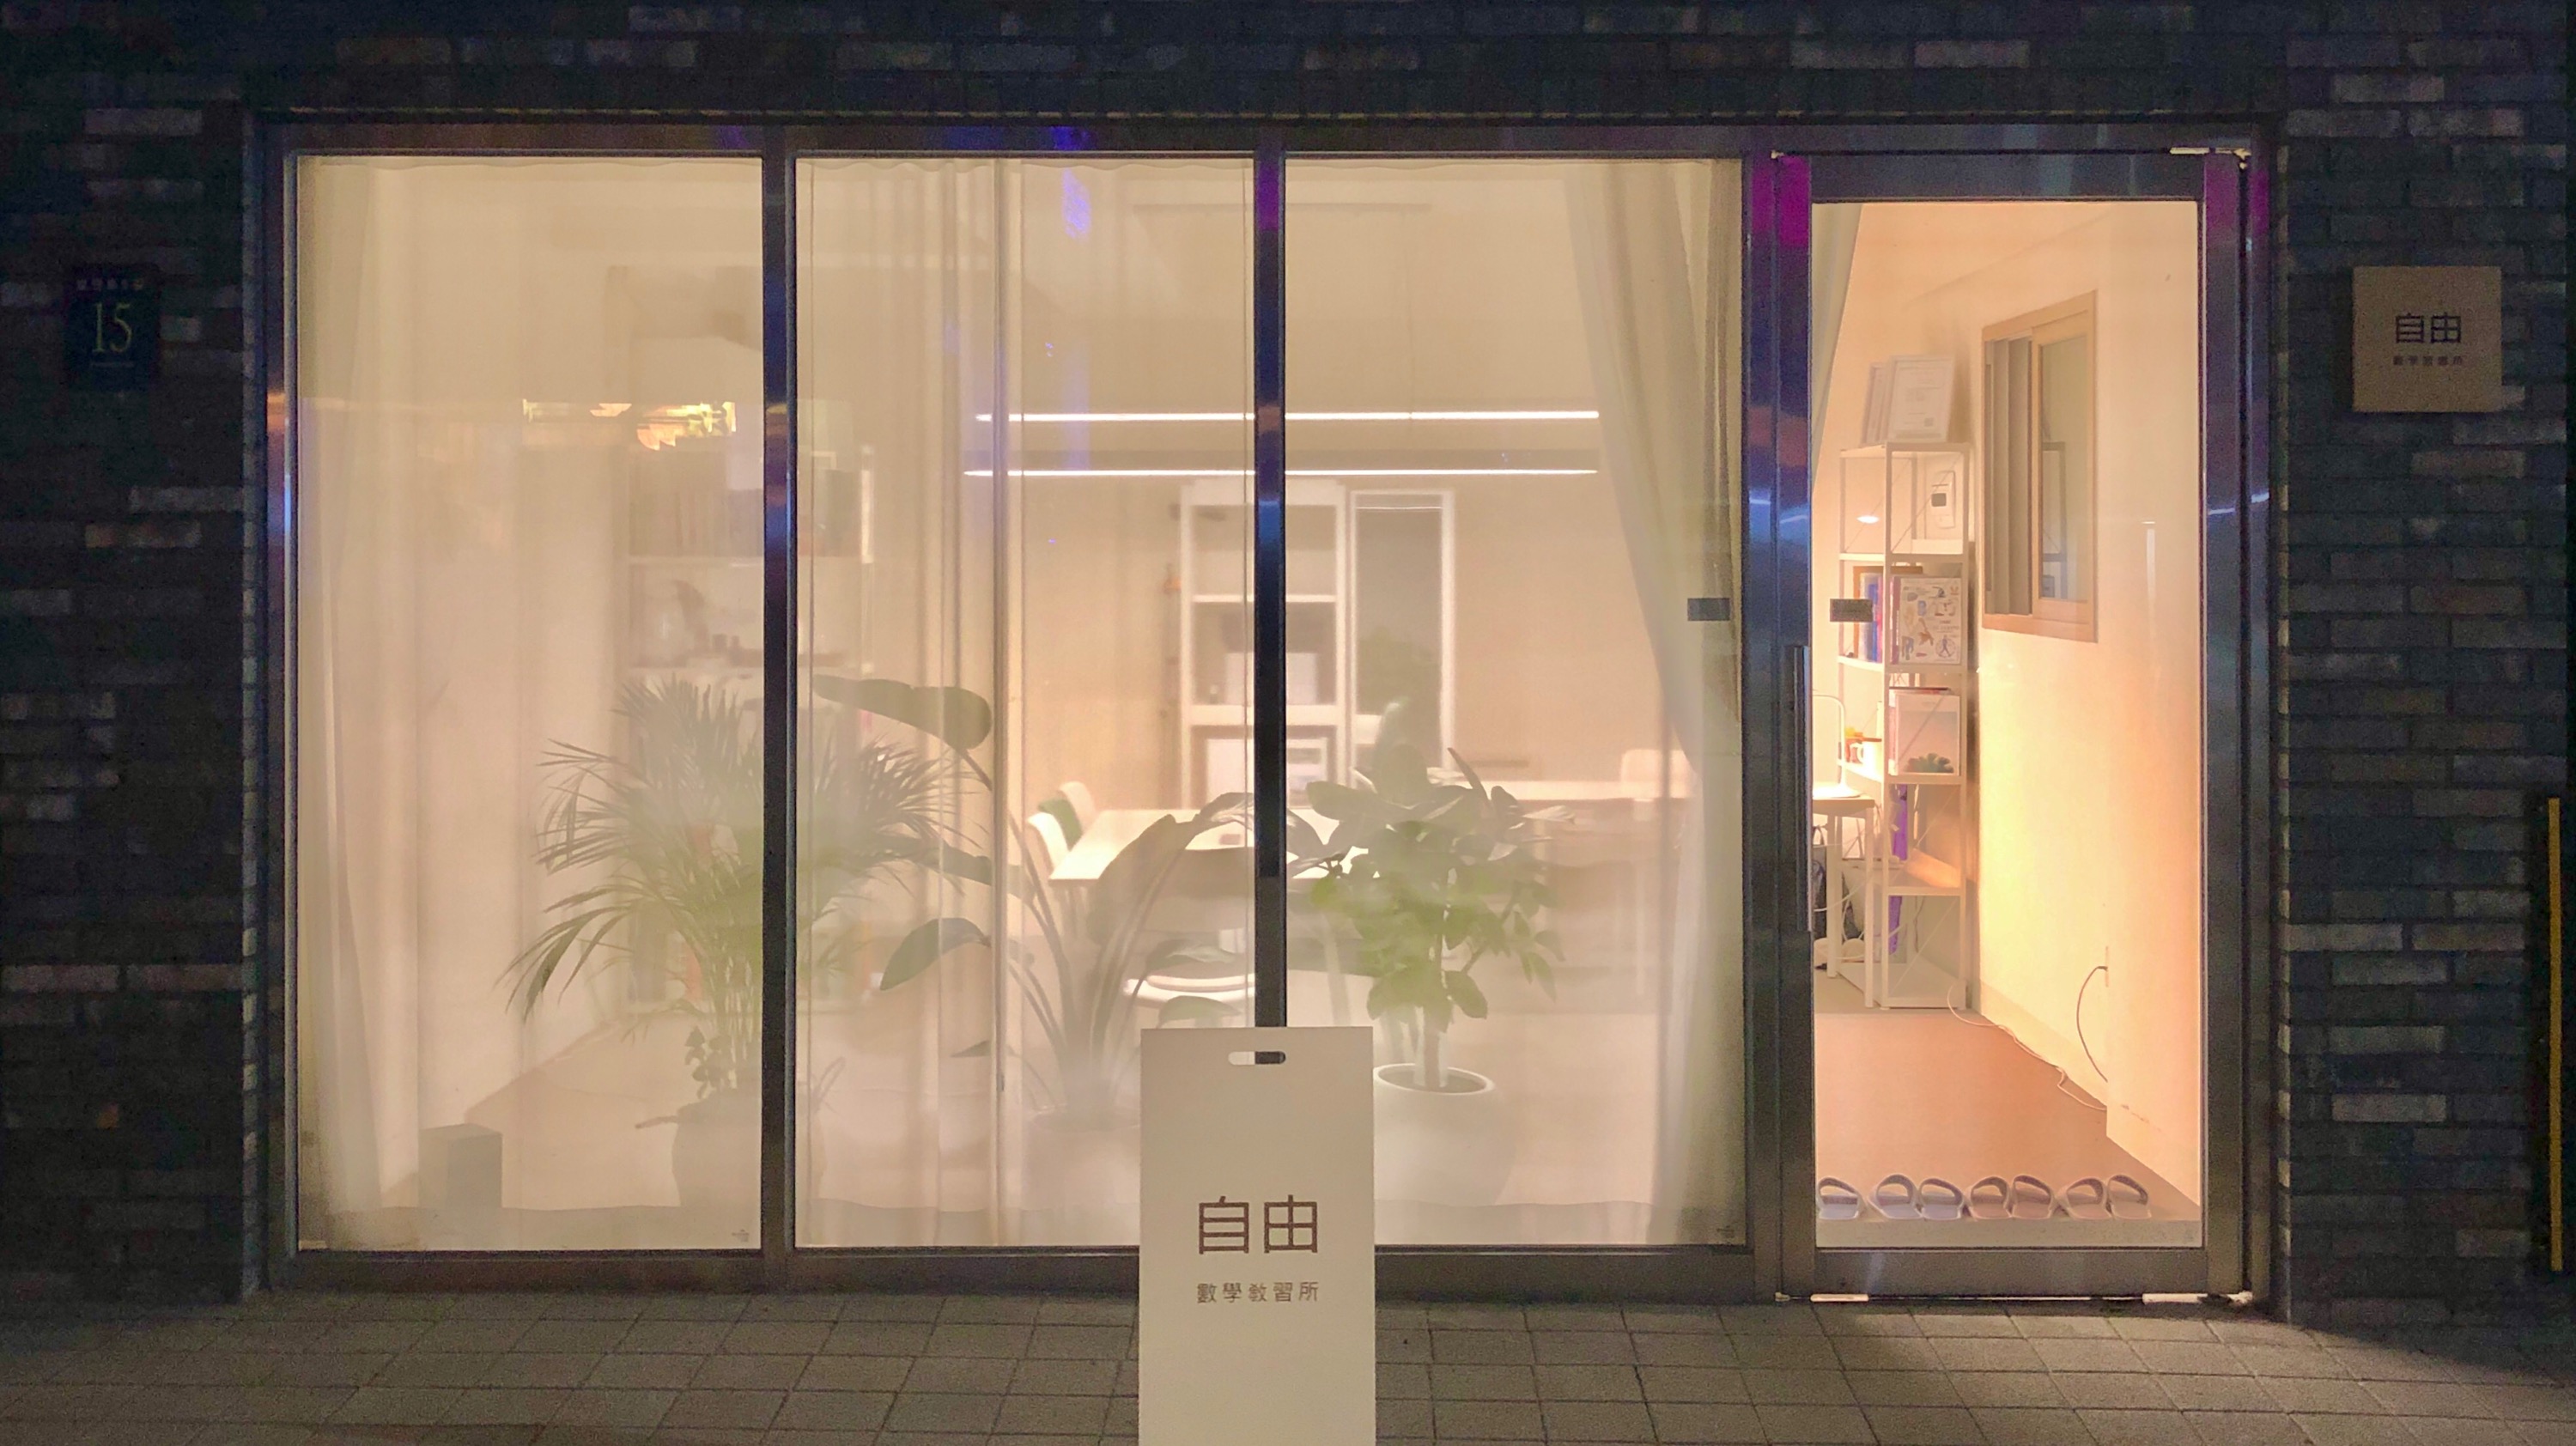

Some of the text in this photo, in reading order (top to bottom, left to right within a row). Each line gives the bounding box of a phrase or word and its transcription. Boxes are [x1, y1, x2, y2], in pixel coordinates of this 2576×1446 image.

[92, 302, 132, 353] 15
[2396, 312, 2461, 343] 自由
[1199, 1194, 1317, 1255] 自由
